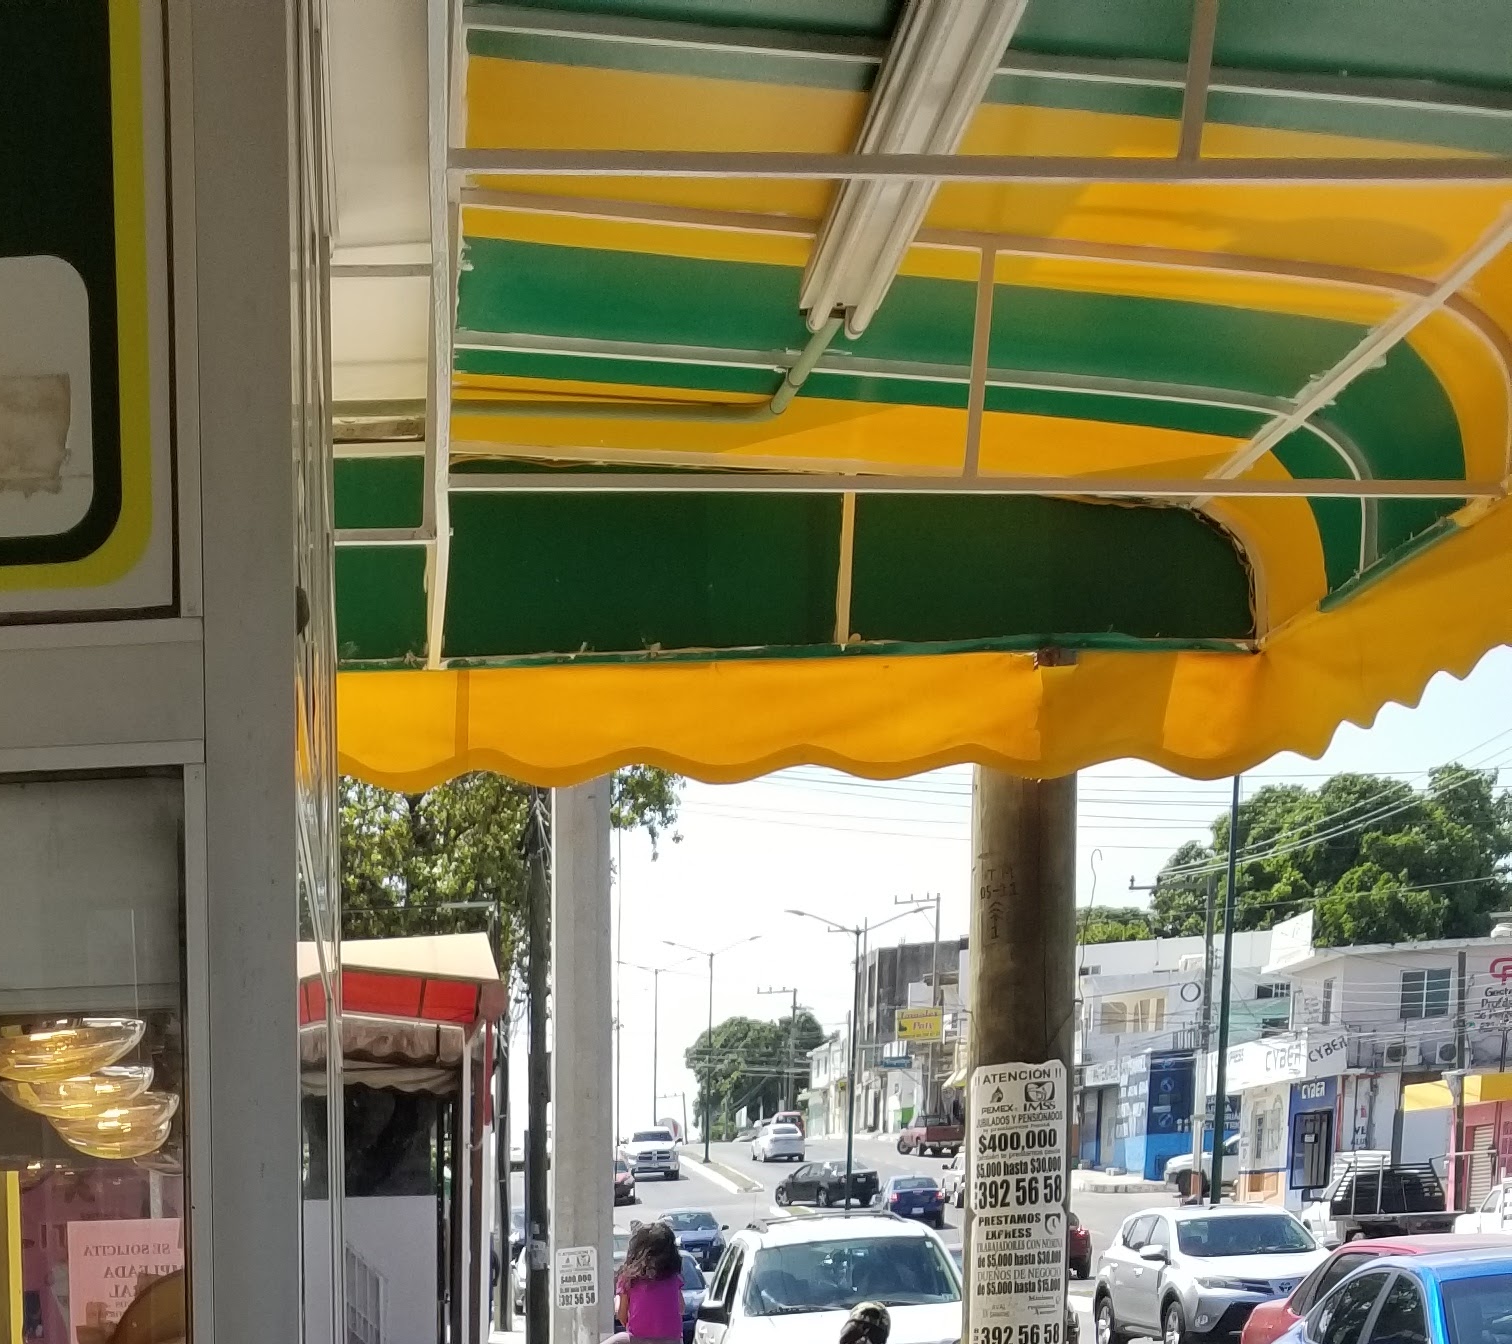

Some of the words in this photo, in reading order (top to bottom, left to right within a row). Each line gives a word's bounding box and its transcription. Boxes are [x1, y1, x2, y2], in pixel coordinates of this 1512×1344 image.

[1265, 1043, 1301, 1072] CYBER
[1308, 1035, 1348, 1063] CYBER
[1023, 1100, 1056, 1112] IMSS
[978, 1128, 1058, 1155] $400,000
[1003, 1160, 1028, 1176] hasta
[978, 1179, 1010, 1210] 392
[1015, 1176, 1039, 1206] 56
[1043, 1174, 1062, 1204] 58
[1014, 1252, 1036, 1266] hasta
[1014, 1280, 1036, 1294] hasta
[1043, 1322, 1060, 1344] 58
